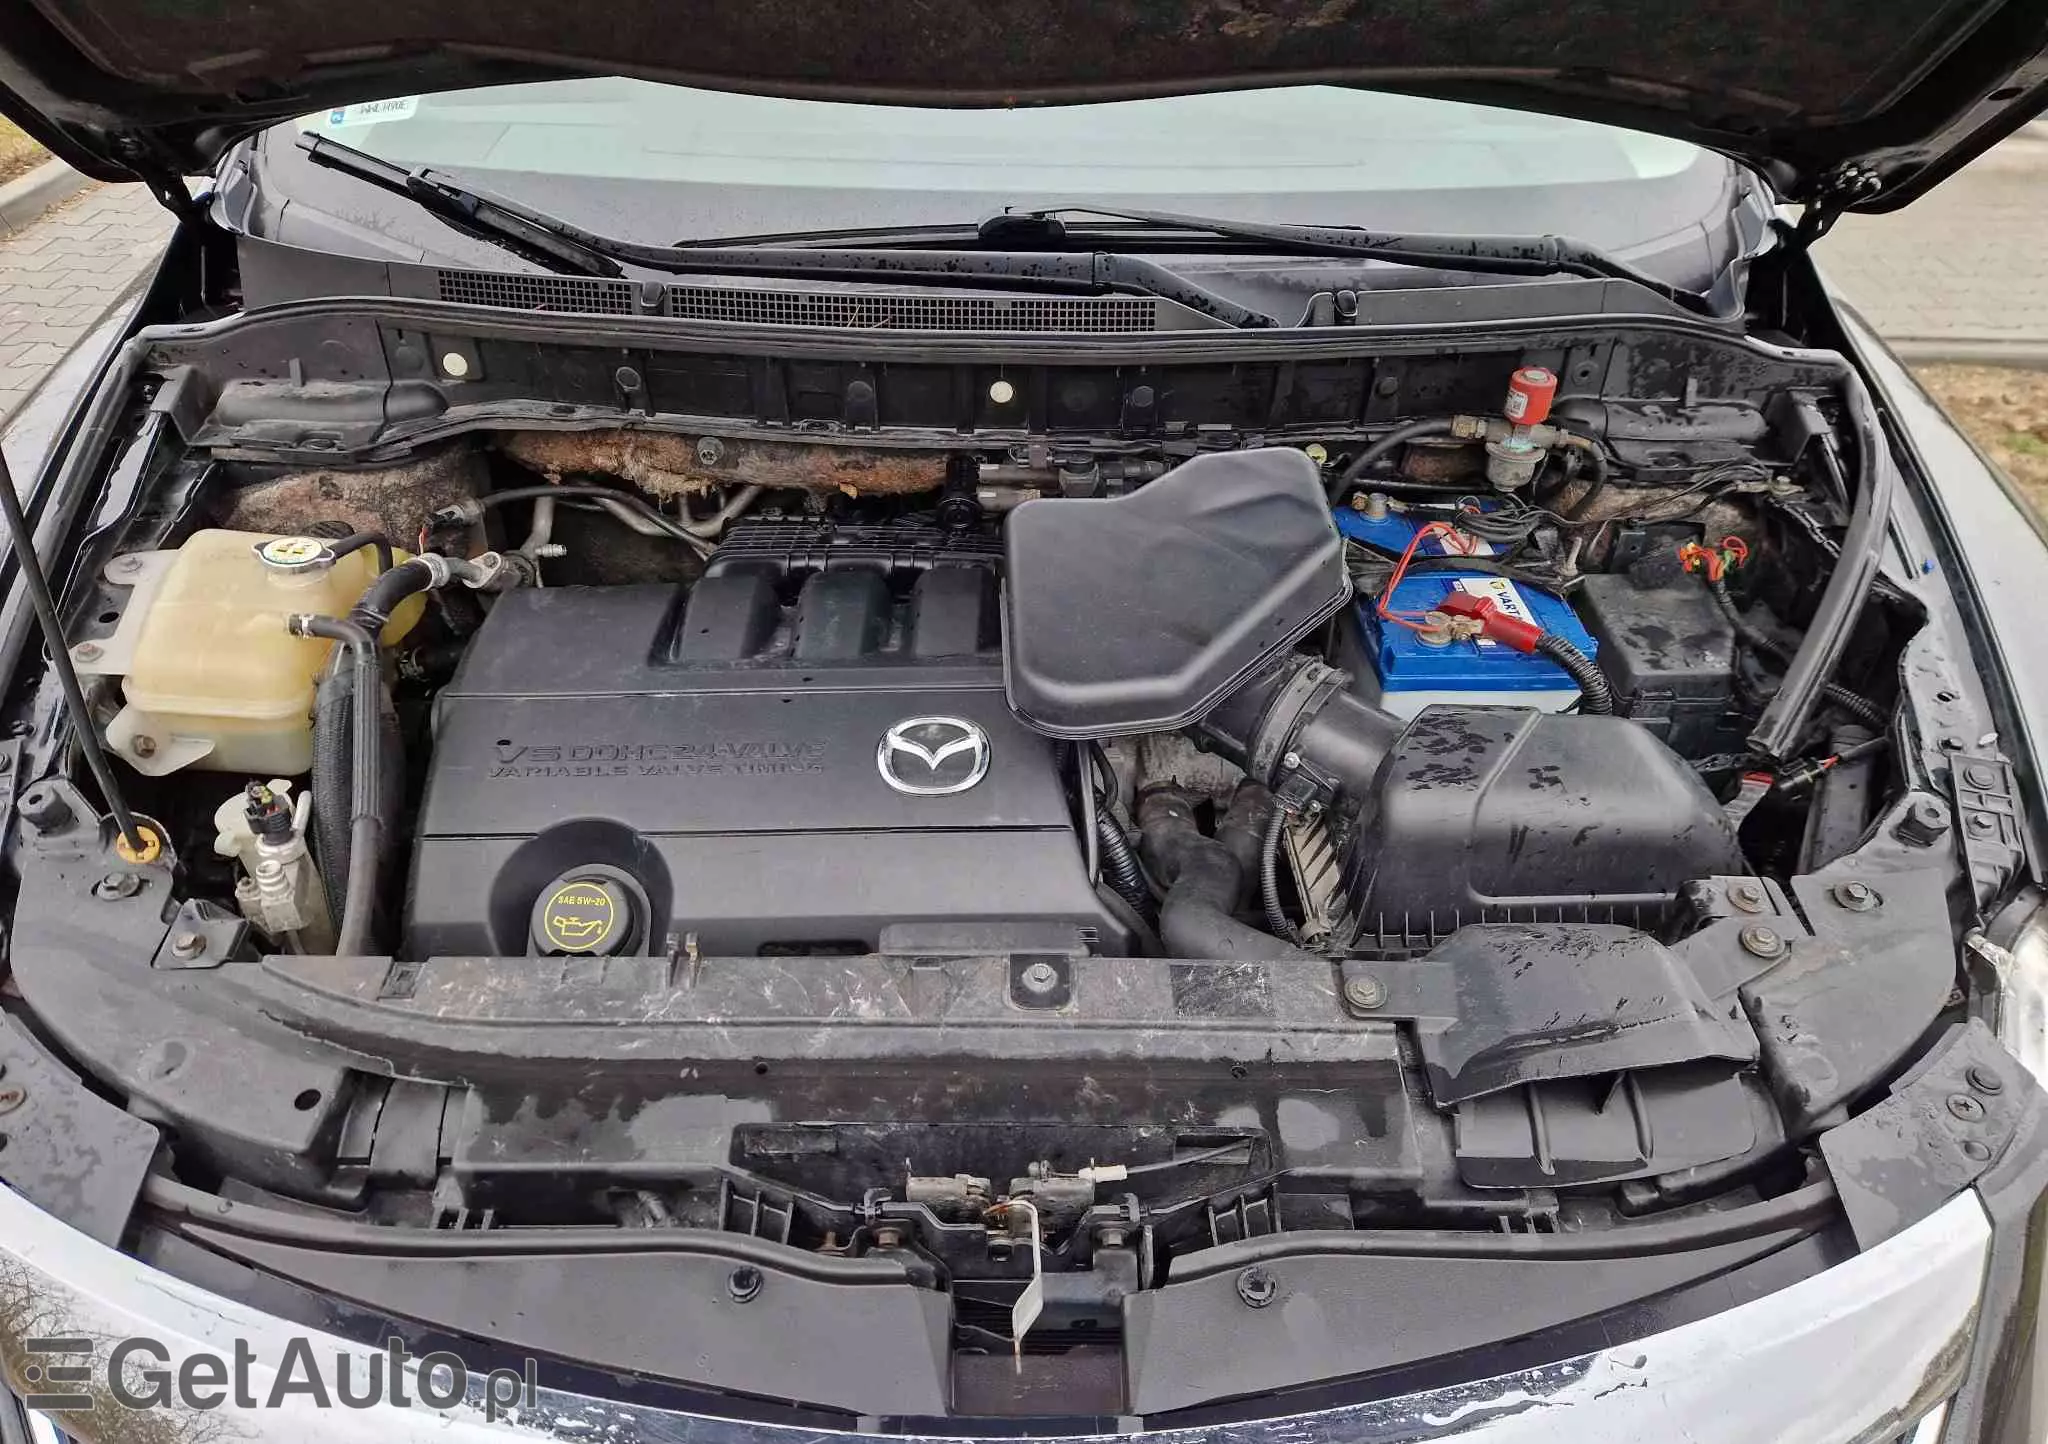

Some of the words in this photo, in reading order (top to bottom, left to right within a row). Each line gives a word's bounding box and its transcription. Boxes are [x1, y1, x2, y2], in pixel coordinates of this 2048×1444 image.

[1497, 591, 1523, 619] VART
[567, 744, 668, 762] DOHC
[490, 766, 629, 778] VARIABLE
[640, 764, 722, 776] VALVE
[558, 896, 575, 905] SAE
[577, 896, 606, 906] 5W-20
